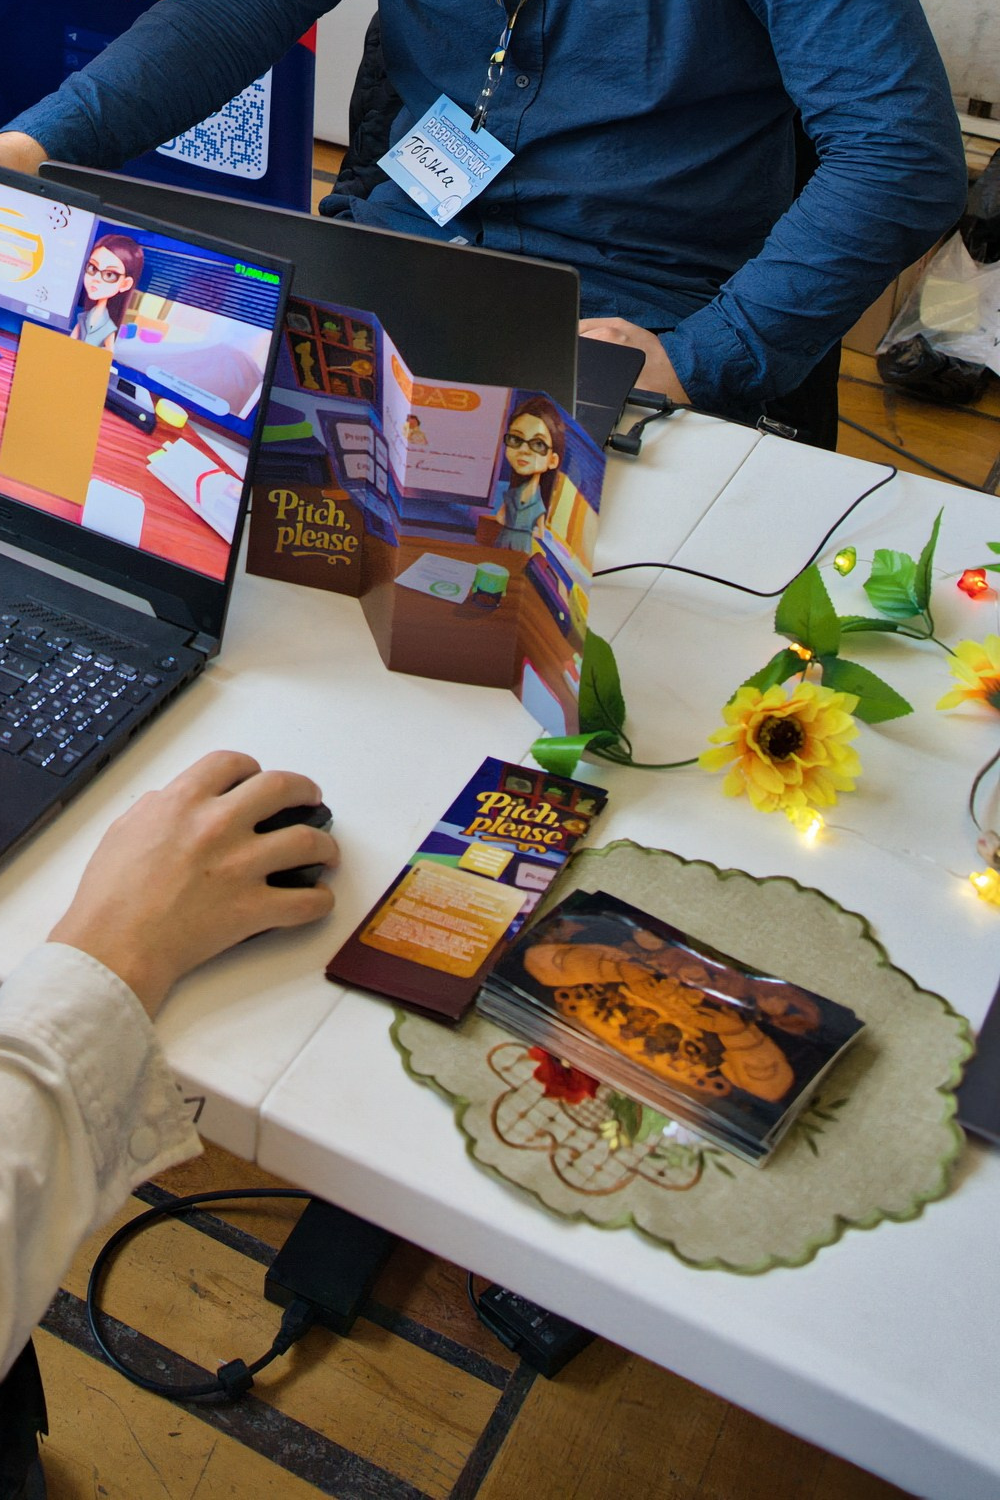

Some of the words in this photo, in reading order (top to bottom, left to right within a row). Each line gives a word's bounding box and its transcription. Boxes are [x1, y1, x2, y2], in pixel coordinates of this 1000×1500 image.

[422, 116, 492, 180] РАЗРАБОТЧИК
[268, 489, 351, 531] Pitch,
[274, 522, 359, 554] please
[476, 791, 560, 828] Pitch,
[461, 815, 563, 845] please
